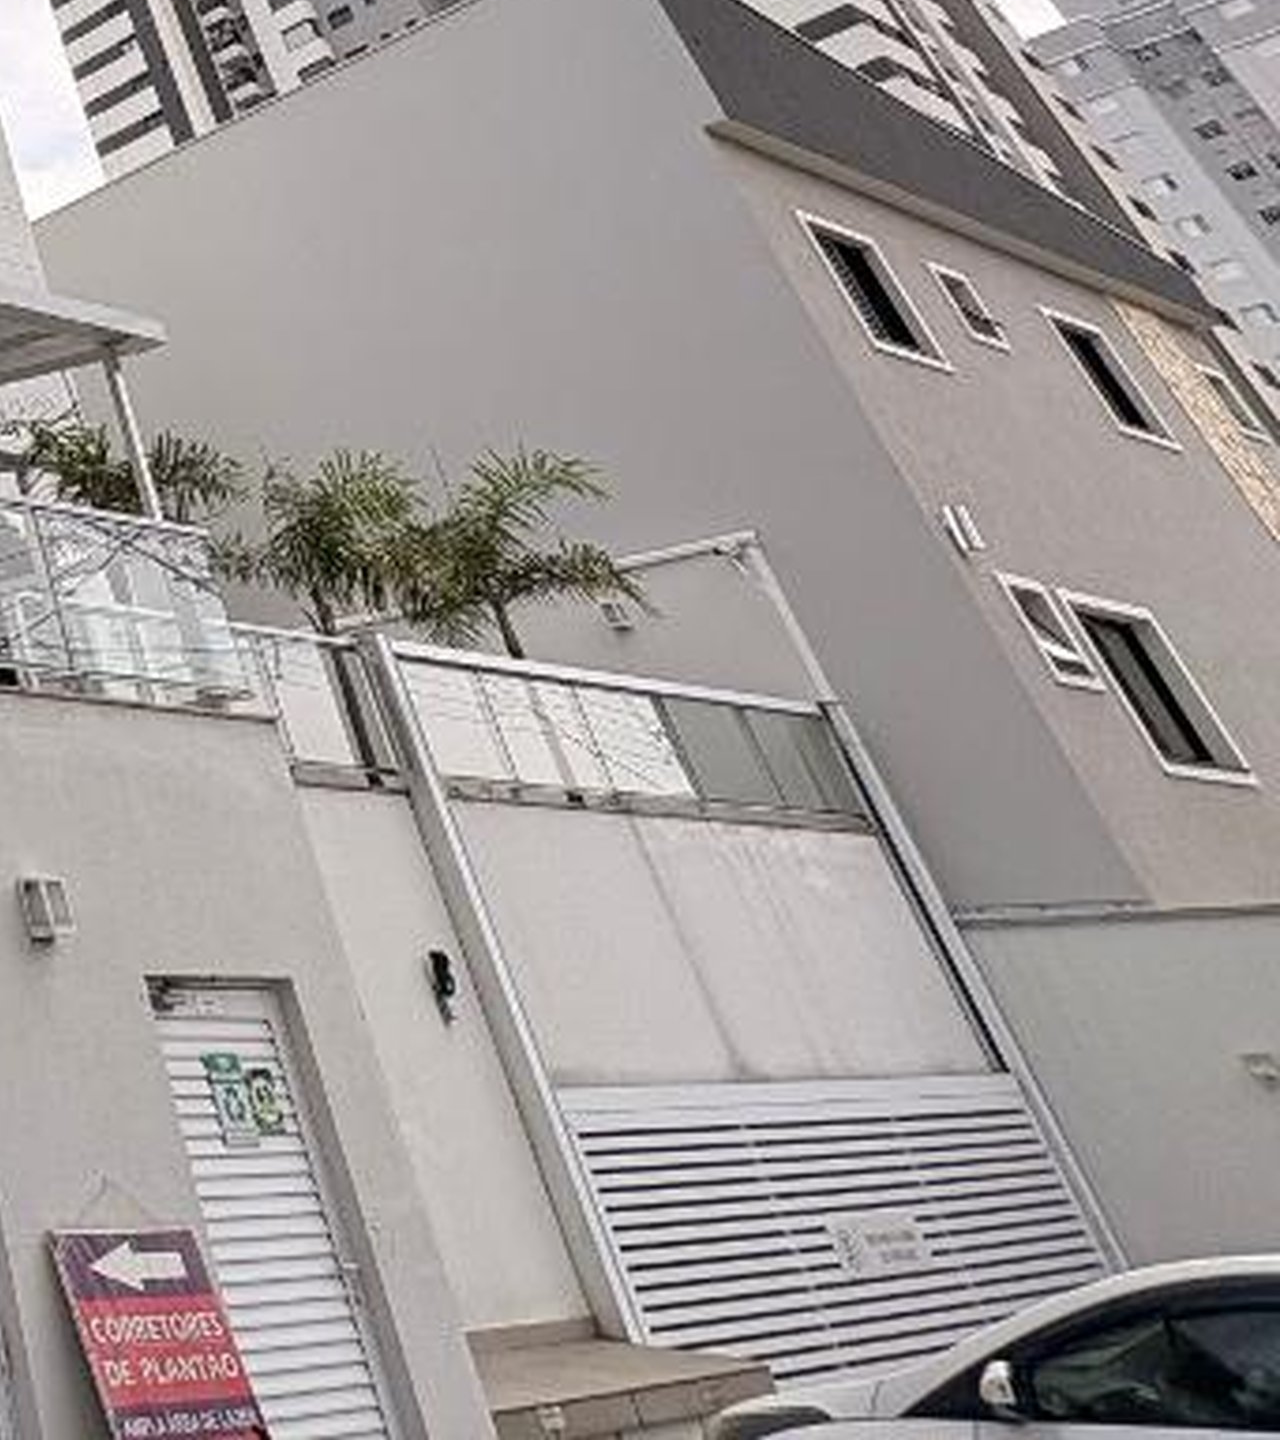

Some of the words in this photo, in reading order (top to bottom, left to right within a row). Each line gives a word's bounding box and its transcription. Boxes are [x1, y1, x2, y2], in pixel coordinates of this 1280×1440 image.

[90, 1311, 224, 1344] CORRETORES
[102, 1359, 137, 1387] DE
[139, 1344, 239, 1386] PLANTÃO
